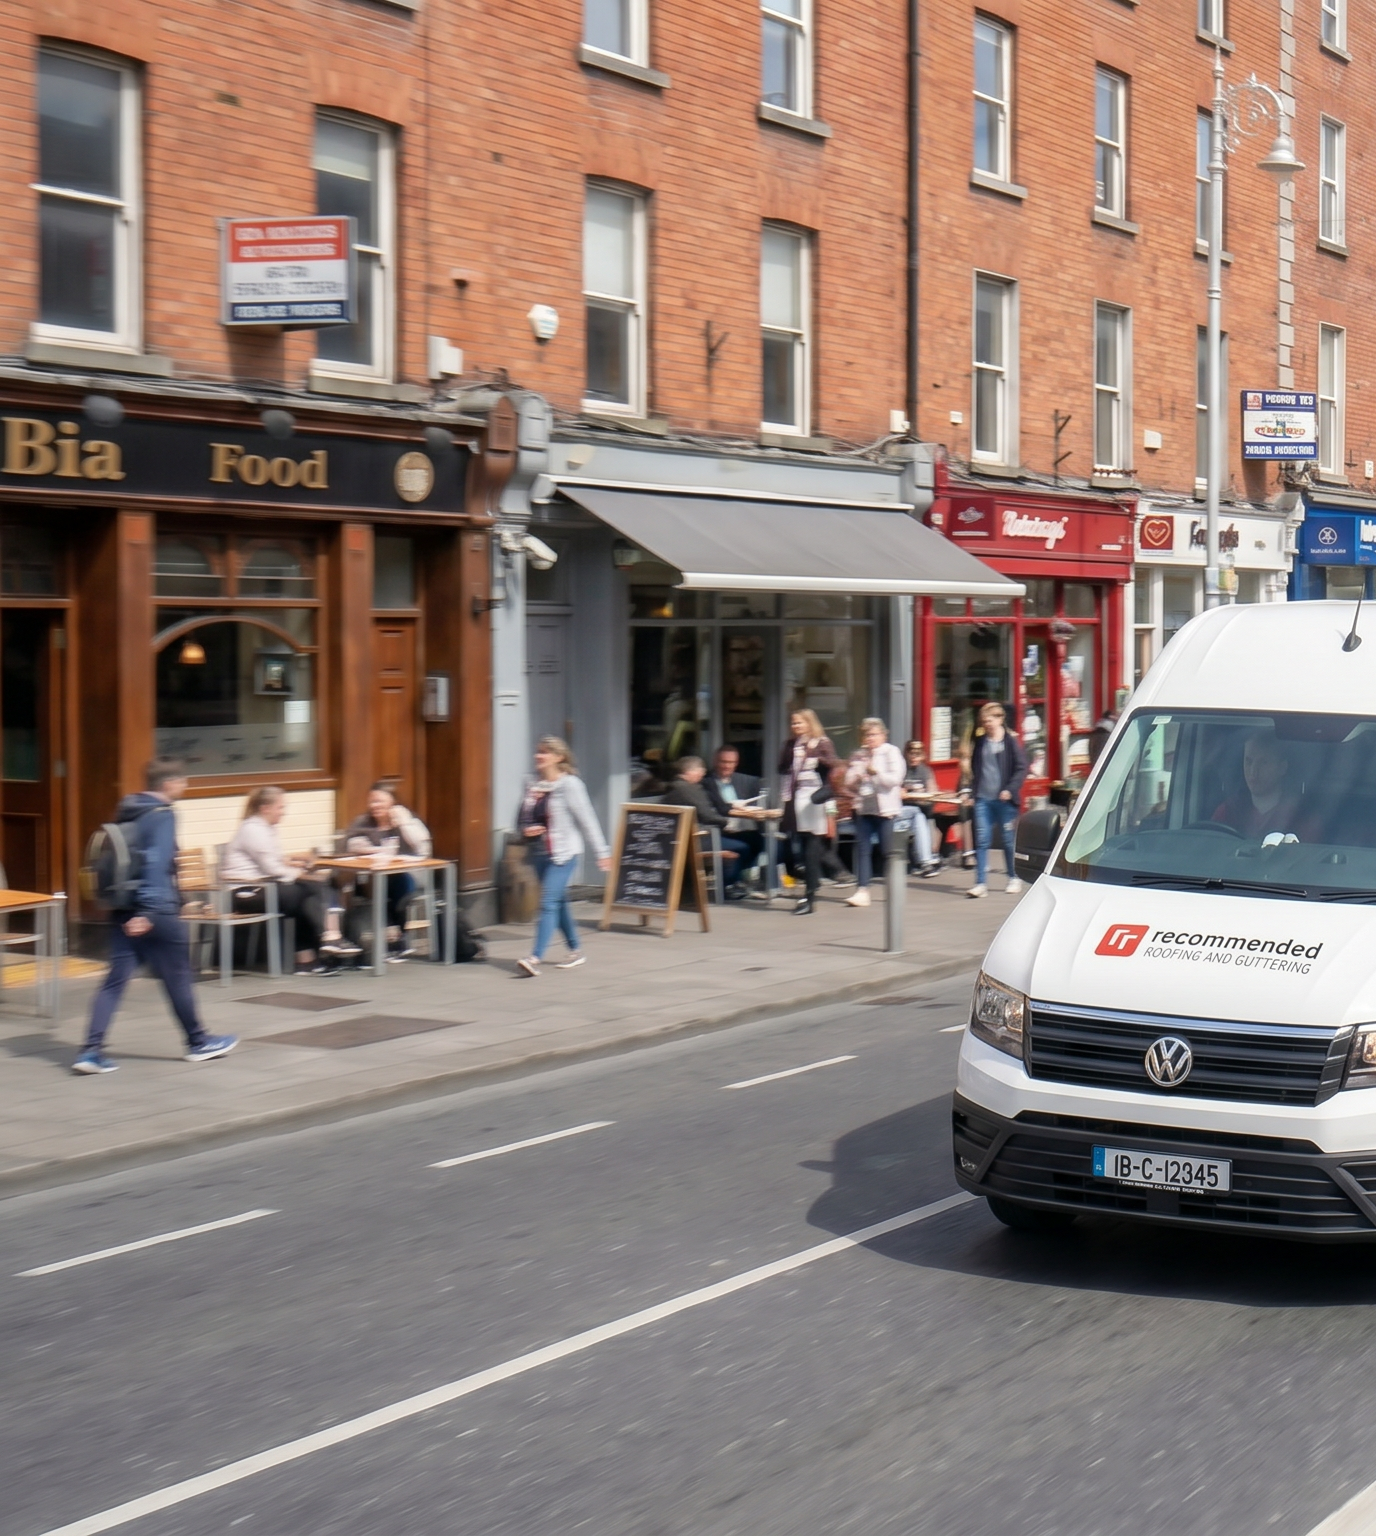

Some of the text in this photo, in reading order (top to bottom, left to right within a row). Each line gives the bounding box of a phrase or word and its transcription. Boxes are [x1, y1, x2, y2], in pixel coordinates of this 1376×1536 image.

[1, 417, 127, 480] Bia
[209, 443, 329, 489] Food
[1144, 947, 1312, 975] ROOFING AND GUTTERING
[1151, 930, 1323, 960] recommended
